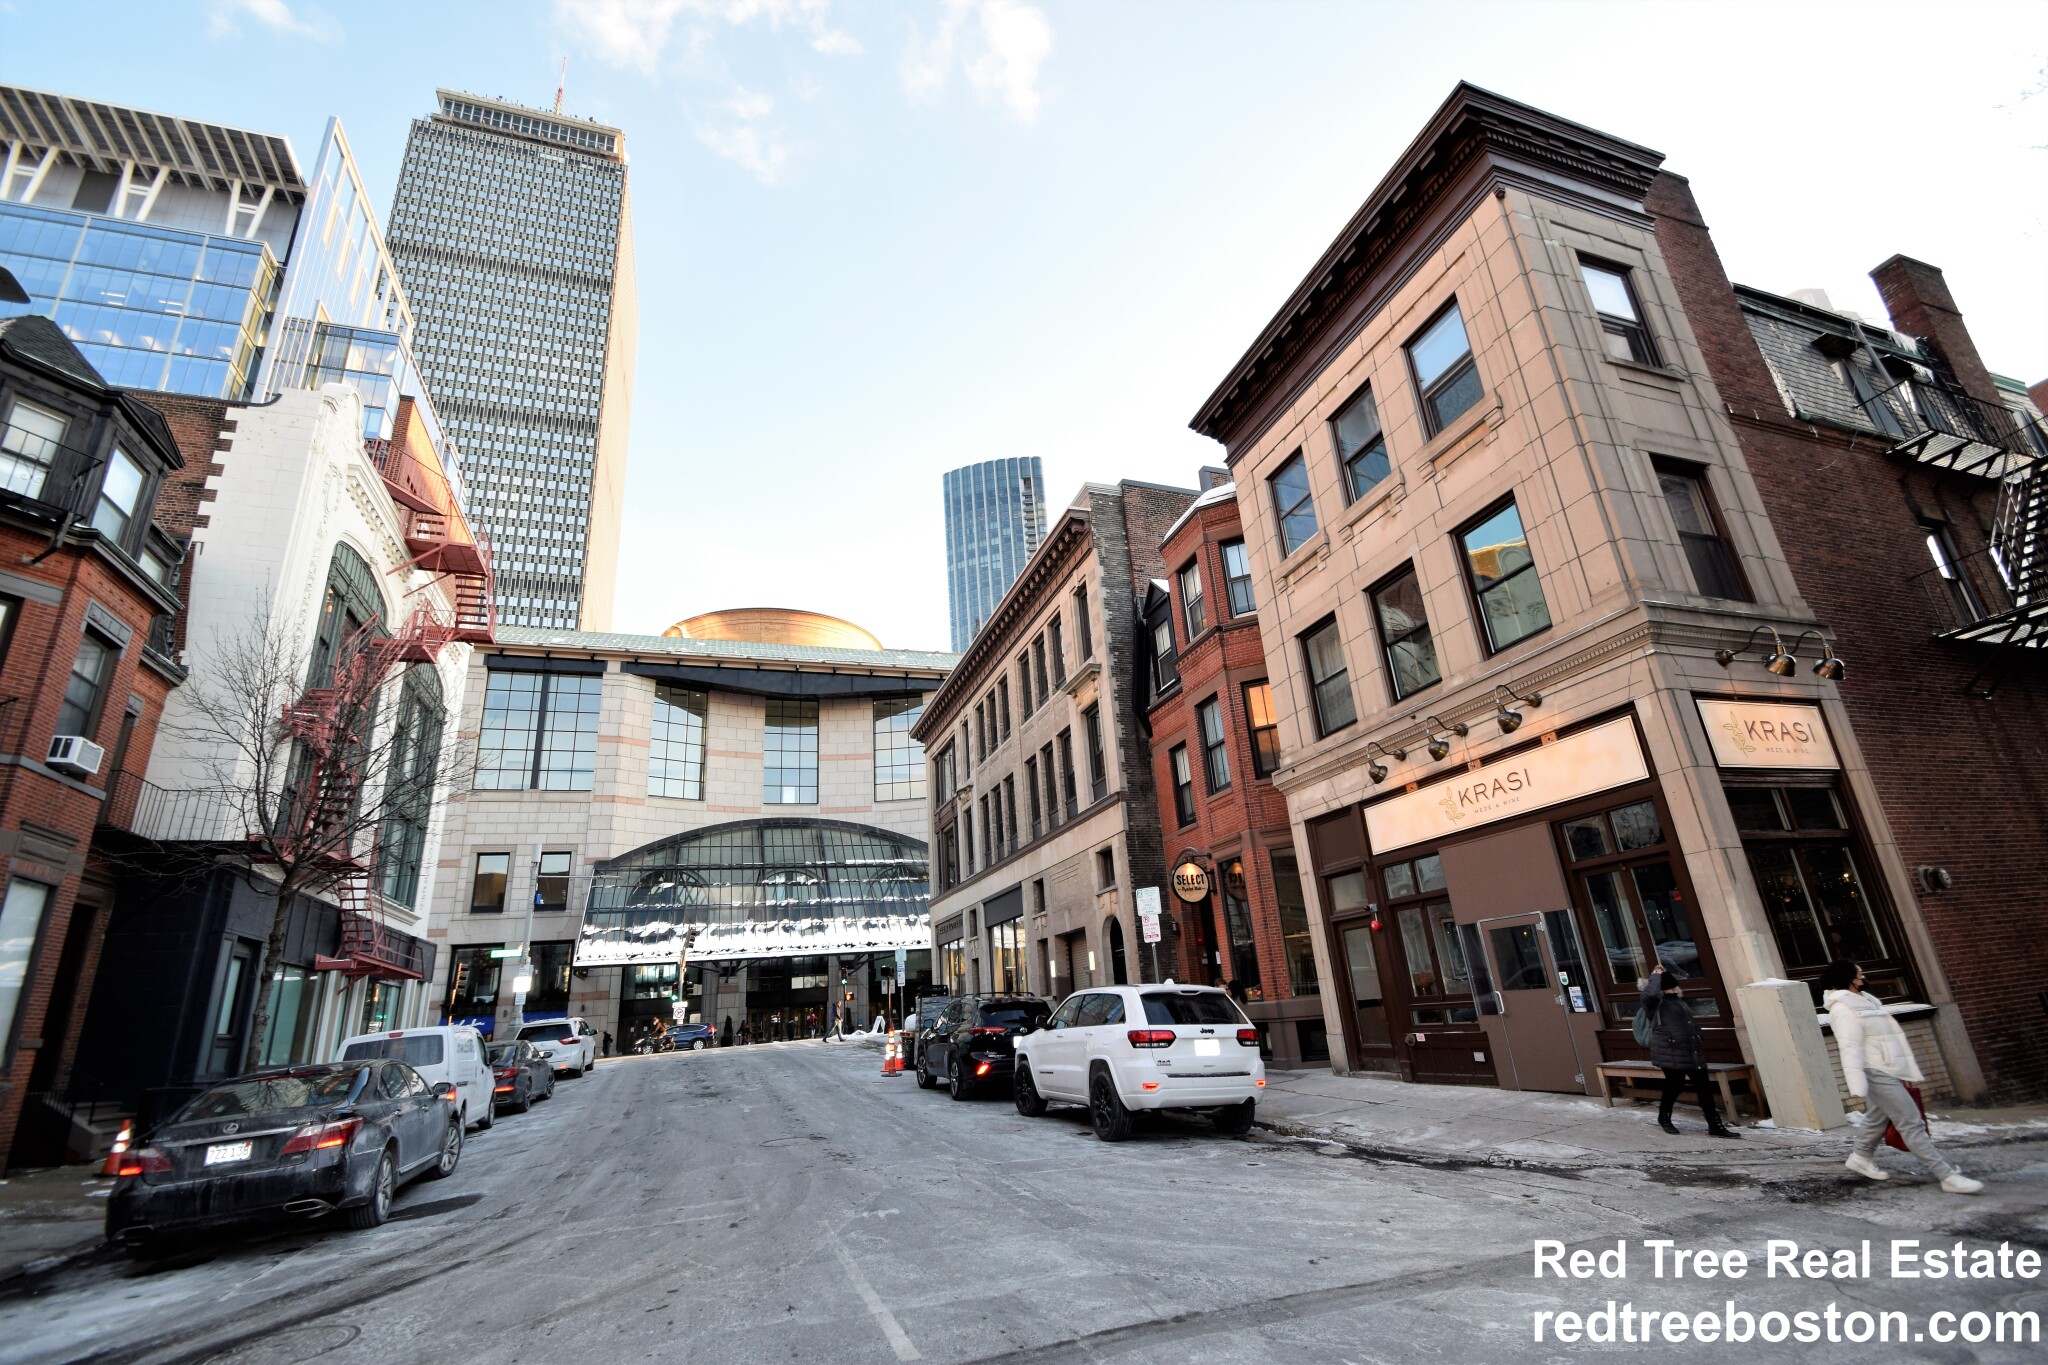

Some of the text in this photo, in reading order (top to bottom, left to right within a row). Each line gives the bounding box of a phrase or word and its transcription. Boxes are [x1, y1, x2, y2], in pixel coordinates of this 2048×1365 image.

[1744, 719, 1817, 744] KRASI
[1457, 768, 1532, 808] KRASI
[1474, 804, 1493, 814] MEZE
[1503, 796, 1521, 806] WINE
[1176, 873, 1205, 886] SELECT
[1200, 1027, 1215, 1035] Jeep
